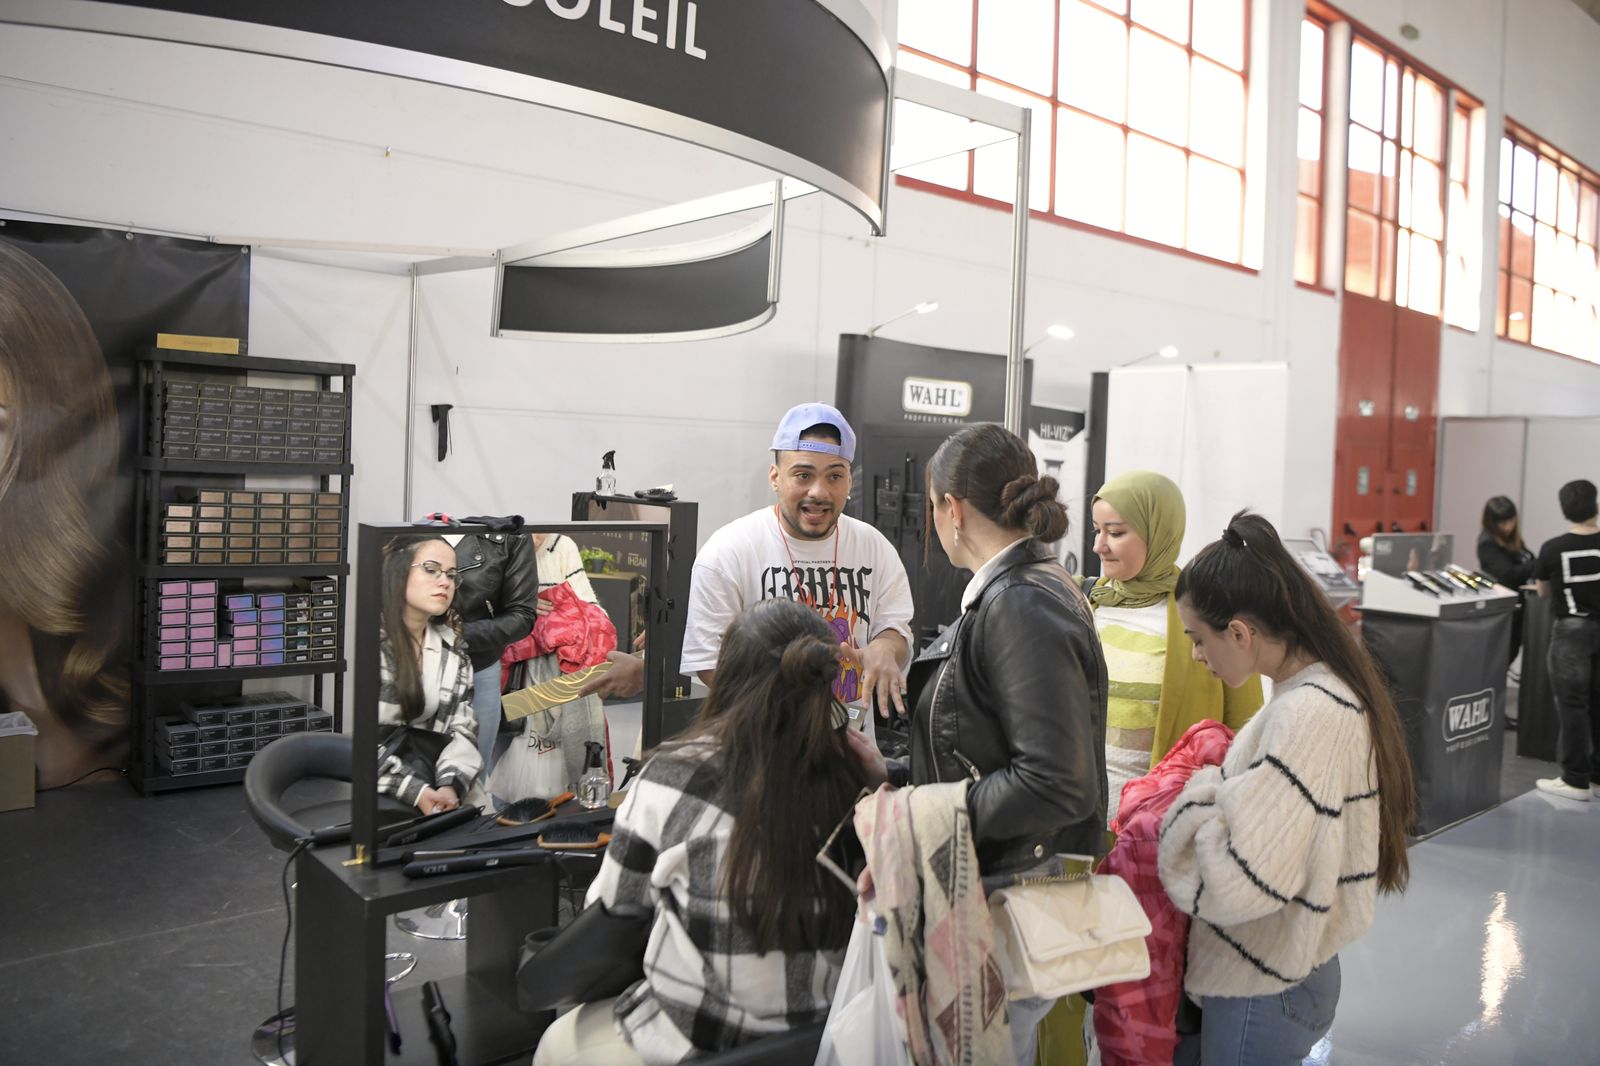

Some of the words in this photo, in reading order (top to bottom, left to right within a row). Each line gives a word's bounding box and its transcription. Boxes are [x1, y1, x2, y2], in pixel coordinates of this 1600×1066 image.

[504, 0, 707, 60] LEIL
[909, 384, 961, 408] WAHL
[1448, 697, 1490, 732] WAHL
